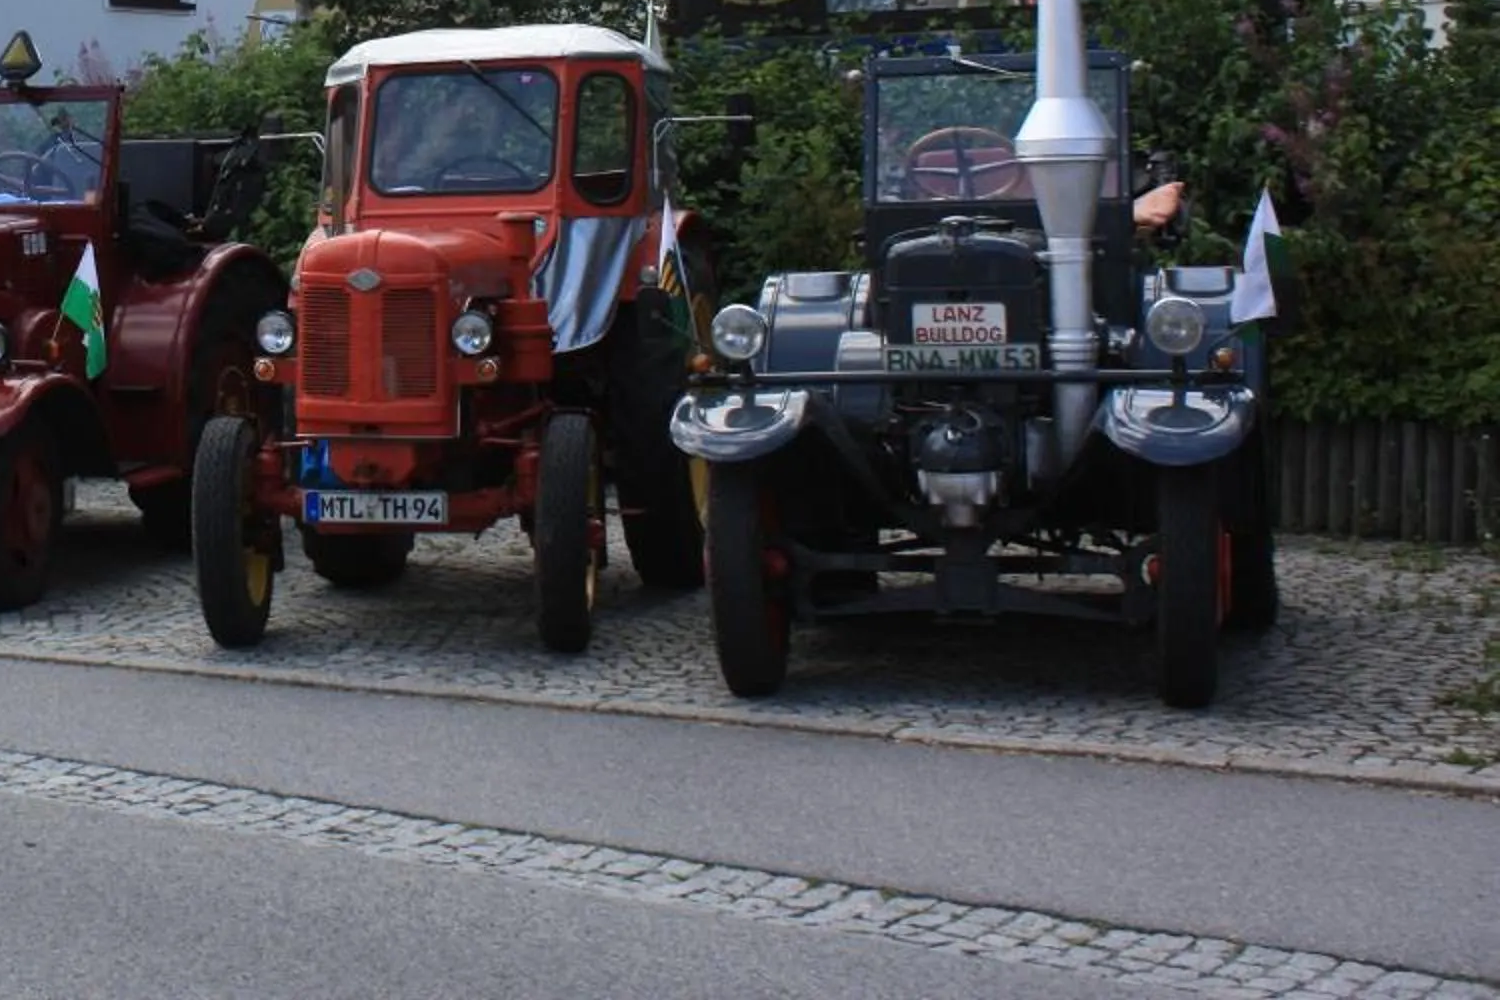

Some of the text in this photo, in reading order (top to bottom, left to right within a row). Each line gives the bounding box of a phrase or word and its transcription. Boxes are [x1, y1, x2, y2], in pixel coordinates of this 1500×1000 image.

[931, 305, 986, 323] LANZ
[914, 326, 1004, 344] BULLDOG
[320, 497, 441, 521] MTL TH 94
